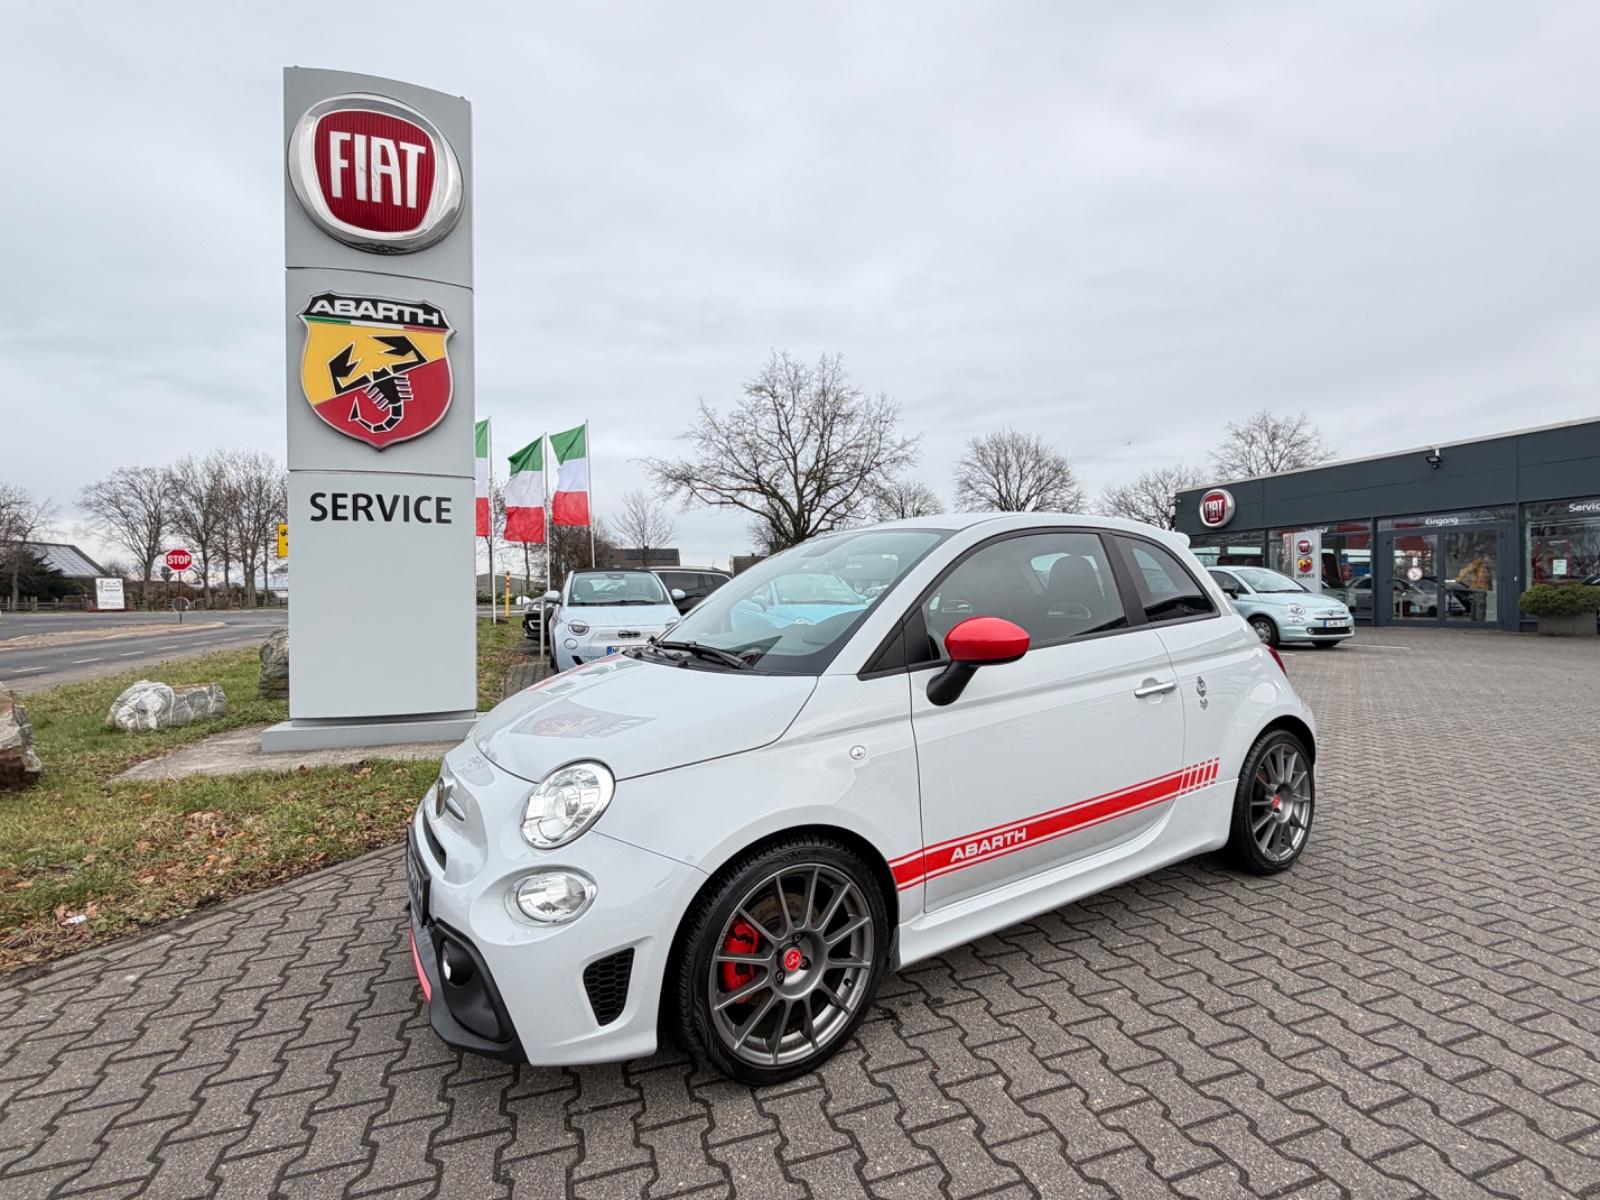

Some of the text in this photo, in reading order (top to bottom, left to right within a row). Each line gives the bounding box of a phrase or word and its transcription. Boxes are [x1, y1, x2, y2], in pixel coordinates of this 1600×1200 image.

[330, 130, 426, 209] FIAT
[310, 299, 439, 325] ABARTH
[309, 492, 452, 524] SERVICE
[1425, 517, 1459, 527] Eingang
[167, 555, 191, 565] STOP
[950, 827, 1027, 863] ABARTH
